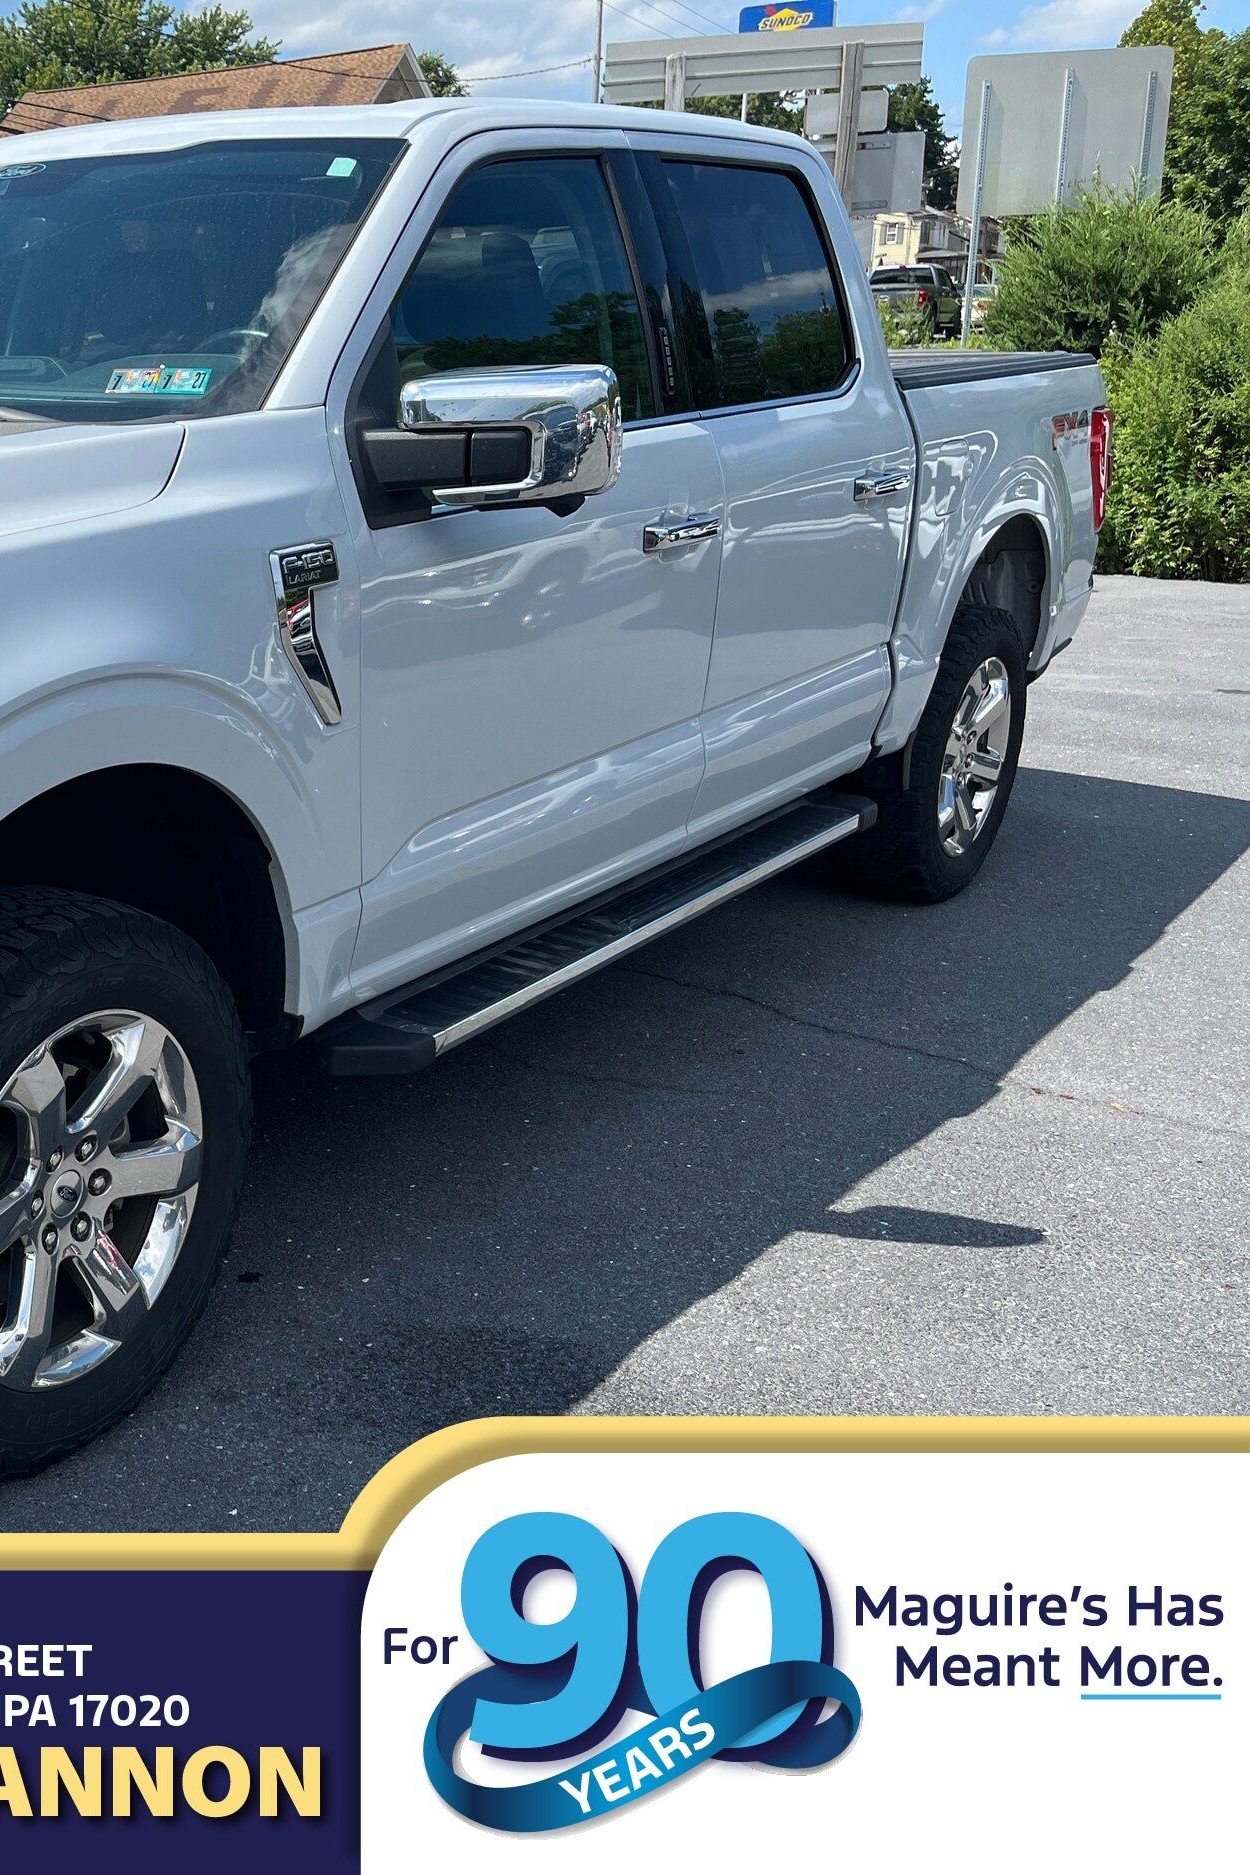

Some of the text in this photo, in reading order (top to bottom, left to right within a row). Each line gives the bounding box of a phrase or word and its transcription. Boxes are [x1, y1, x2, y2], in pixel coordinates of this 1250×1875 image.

[761, 14, 810, 28] SUNOCO
[112, 375, 123, 390] 7
[162, 371, 208, 390] 7 27
[282, 550, 335, 574] F-150
[288, 570, 322, 584] LARIAT
